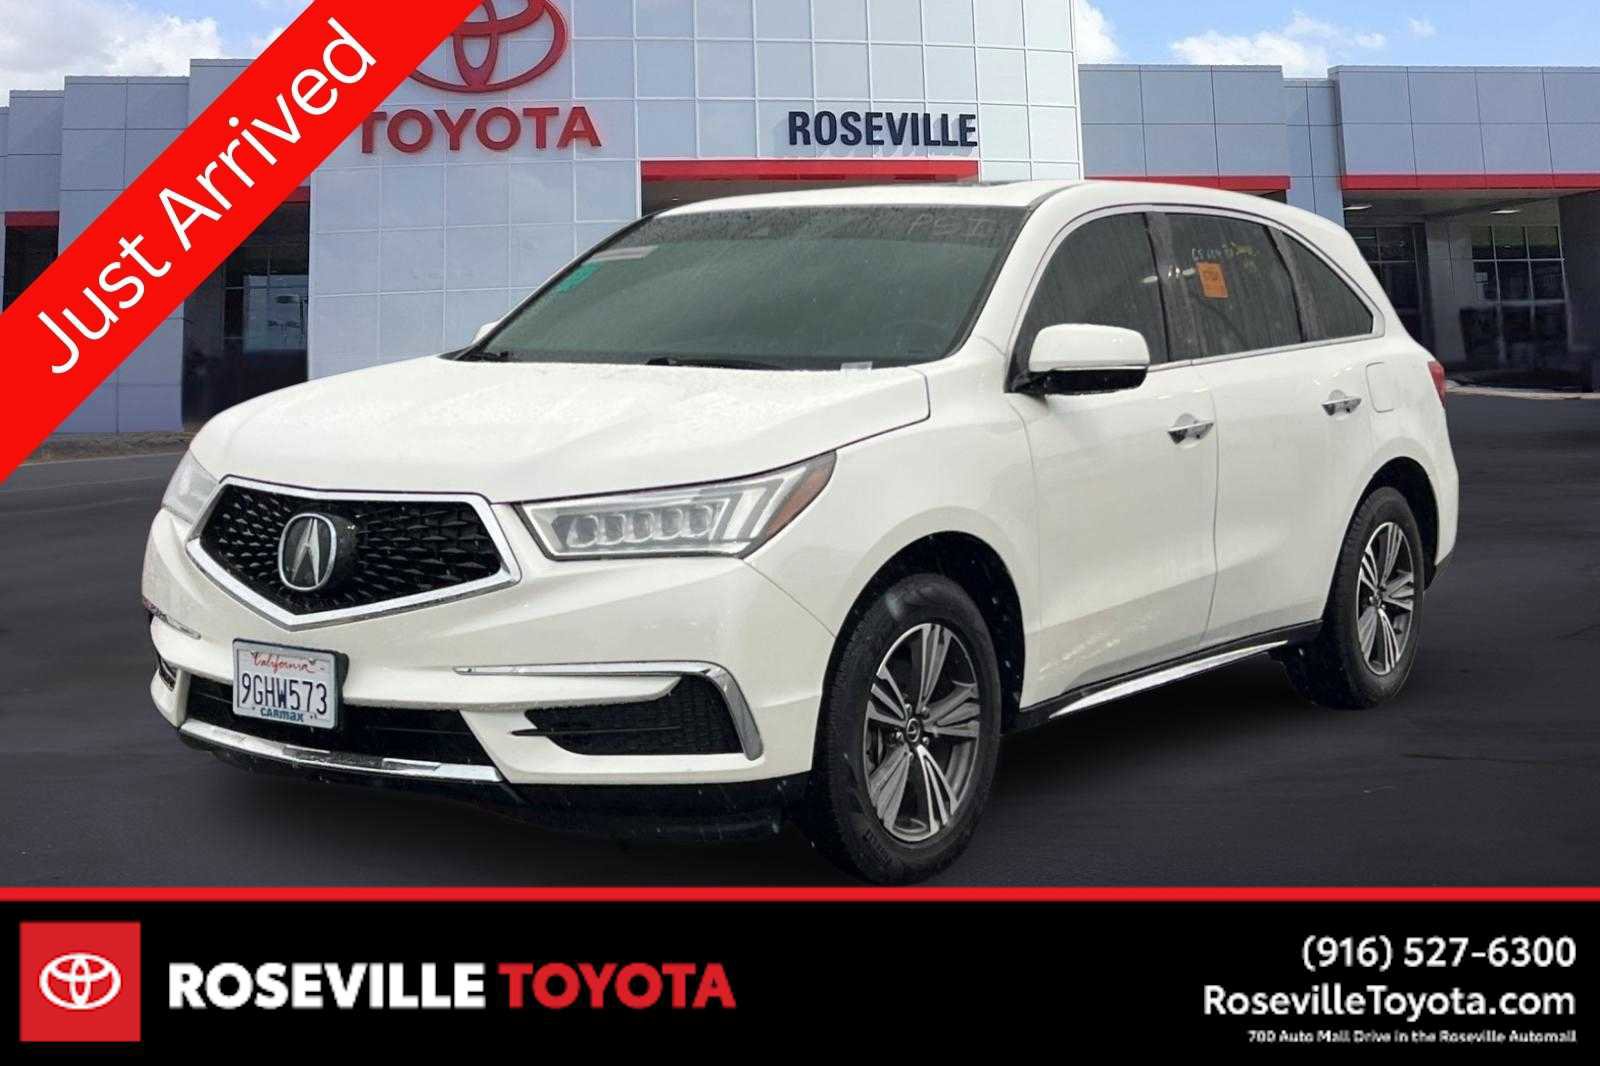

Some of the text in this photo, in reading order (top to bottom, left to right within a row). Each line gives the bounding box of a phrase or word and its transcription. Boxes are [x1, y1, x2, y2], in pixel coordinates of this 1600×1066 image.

[361, 106, 602, 154] TOYOTA
[788, 110, 978, 147] ROSEVILLE
[251, 652, 315, 673] California
[241, 672, 327, 715] 9GHW573
